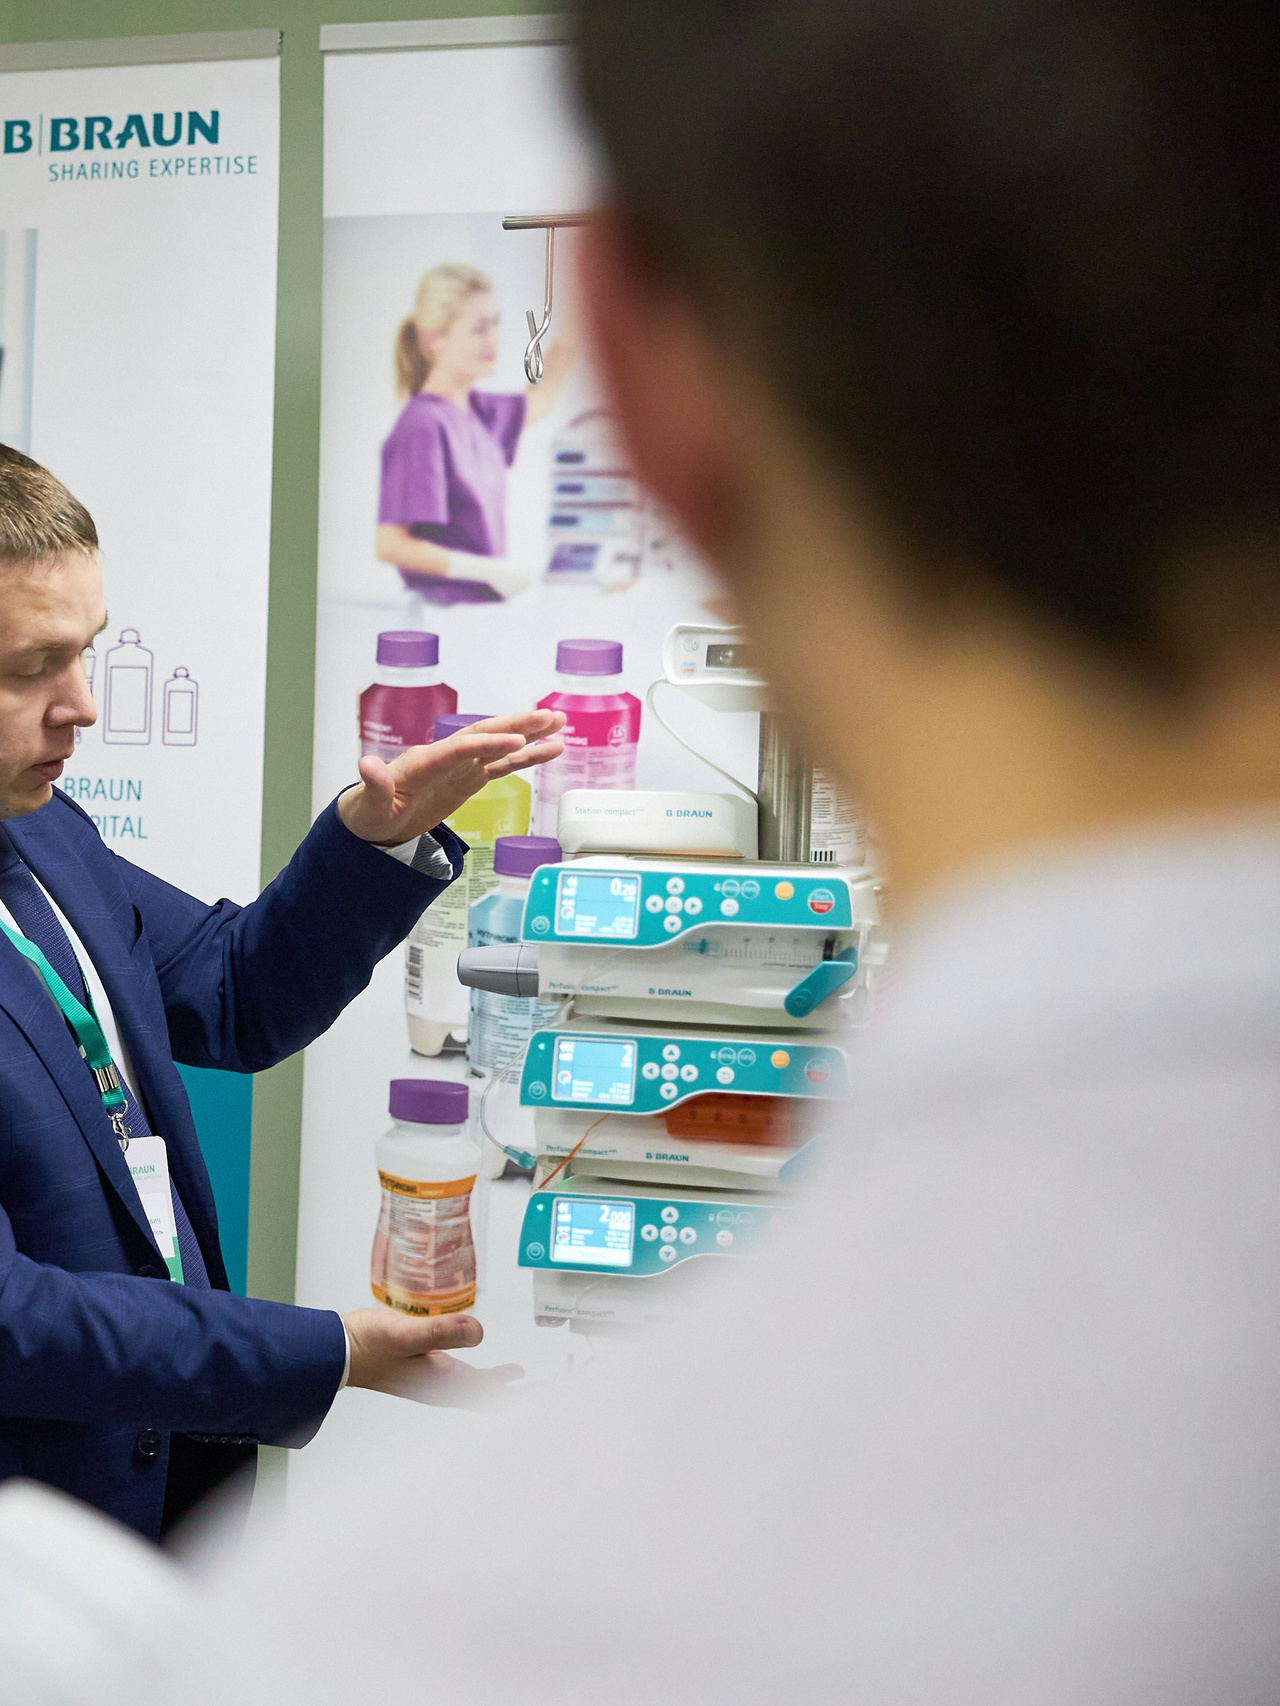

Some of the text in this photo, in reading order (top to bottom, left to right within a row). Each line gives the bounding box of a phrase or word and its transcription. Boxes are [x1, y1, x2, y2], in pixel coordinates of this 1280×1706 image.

[3, 109, 220, 155] B BRAUN
[48, 155, 258, 183] SHARING EXPERTISE
[575, 807, 602, 816] Station
[665, 809, 714, 819] B BRAUN
[648, 987, 692, 997] B BRAUN
[645, 1152, 690, 1162] B BRAUN
